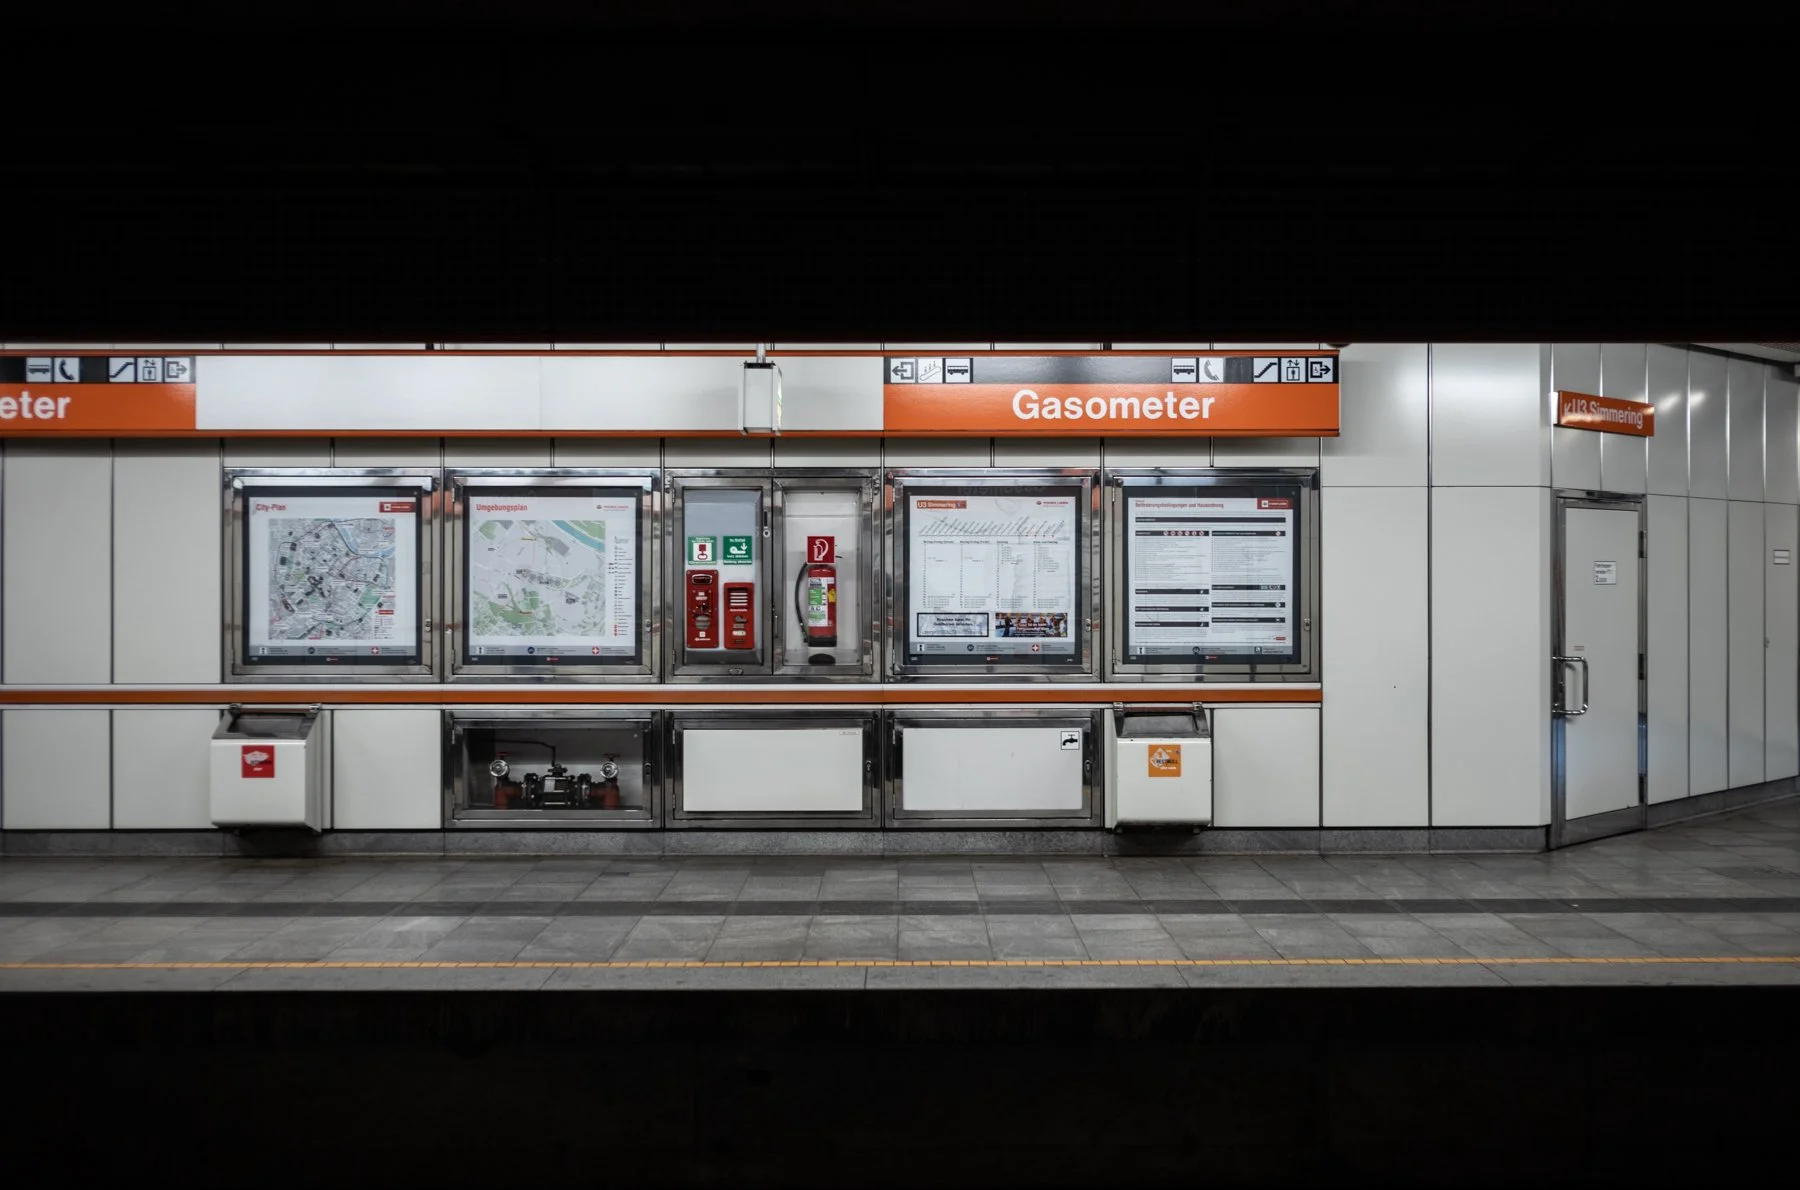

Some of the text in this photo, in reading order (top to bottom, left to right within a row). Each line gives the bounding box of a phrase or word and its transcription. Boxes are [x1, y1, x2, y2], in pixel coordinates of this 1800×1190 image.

[0, 391, 72, 419] eter
[1012, 389, 1216, 419] Gasometer
[1572, 398, 1643, 429] U3 Simmering
[255, 503, 287, 512] City-Plan
[476, 503, 528, 512] Umgebungsplan
